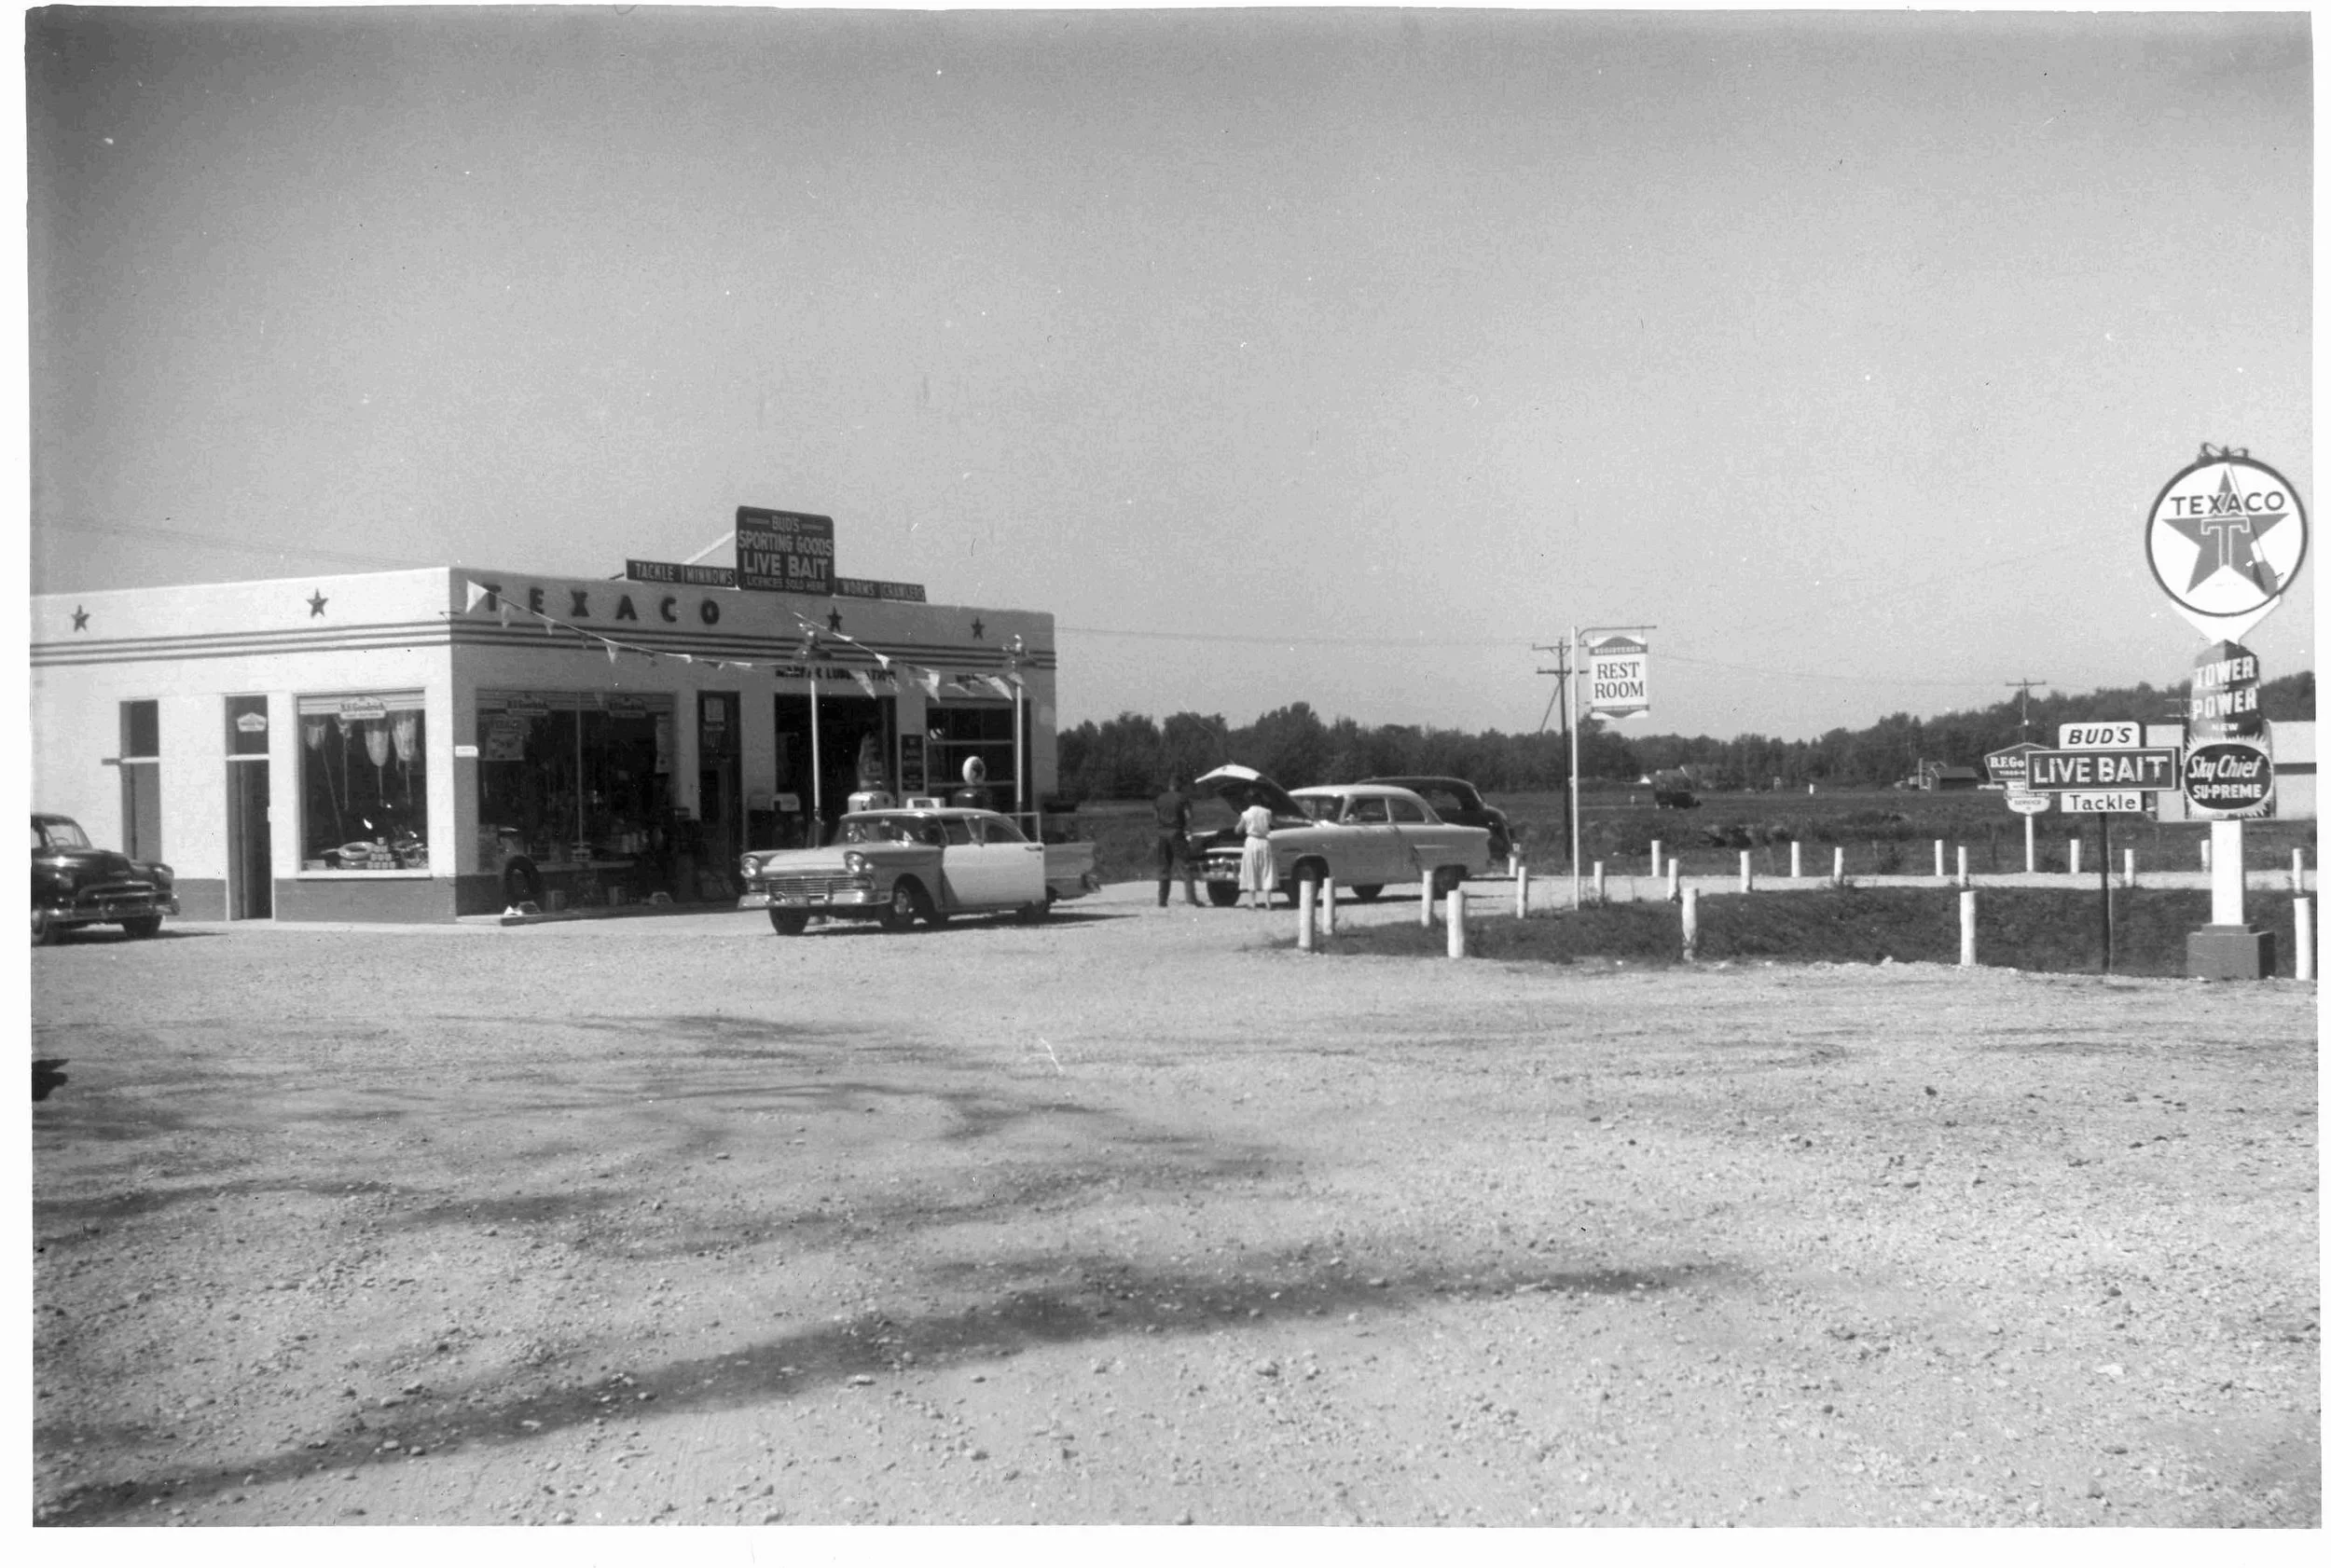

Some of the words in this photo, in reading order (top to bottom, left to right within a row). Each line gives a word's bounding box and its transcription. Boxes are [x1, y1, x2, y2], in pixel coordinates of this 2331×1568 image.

[2170, 490, 2285, 516] TEXACO
[738, 530, 793, 553] SPORTING
[795, 537, 834, 557] GOODS
[635, 562, 675, 582] TACKLE
[685, 566, 735, 586] MINNOWS
[743, 550, 781, 576] LIVE
[788, 557, 828, 580] BAIT
[482, 585, 720, 625] TEXACO
[1597, 662, 1639, 679] REST
[2194, 655, 2255, 688] TOWER
[1594, 681, 1644, 698] ROOM
[2191, 687, 2256, 721] POWER
[2068, 726, 2133, 745] BUD'S
[2034, 757, 2091, 783] LIVE
[2098, 756, 2168, 783] BAIT
[2188, 756, 2216, 781] Sky
[2217, 755, 2264, 777] Chief
[2069, 794, 2136, 811] Tackle
